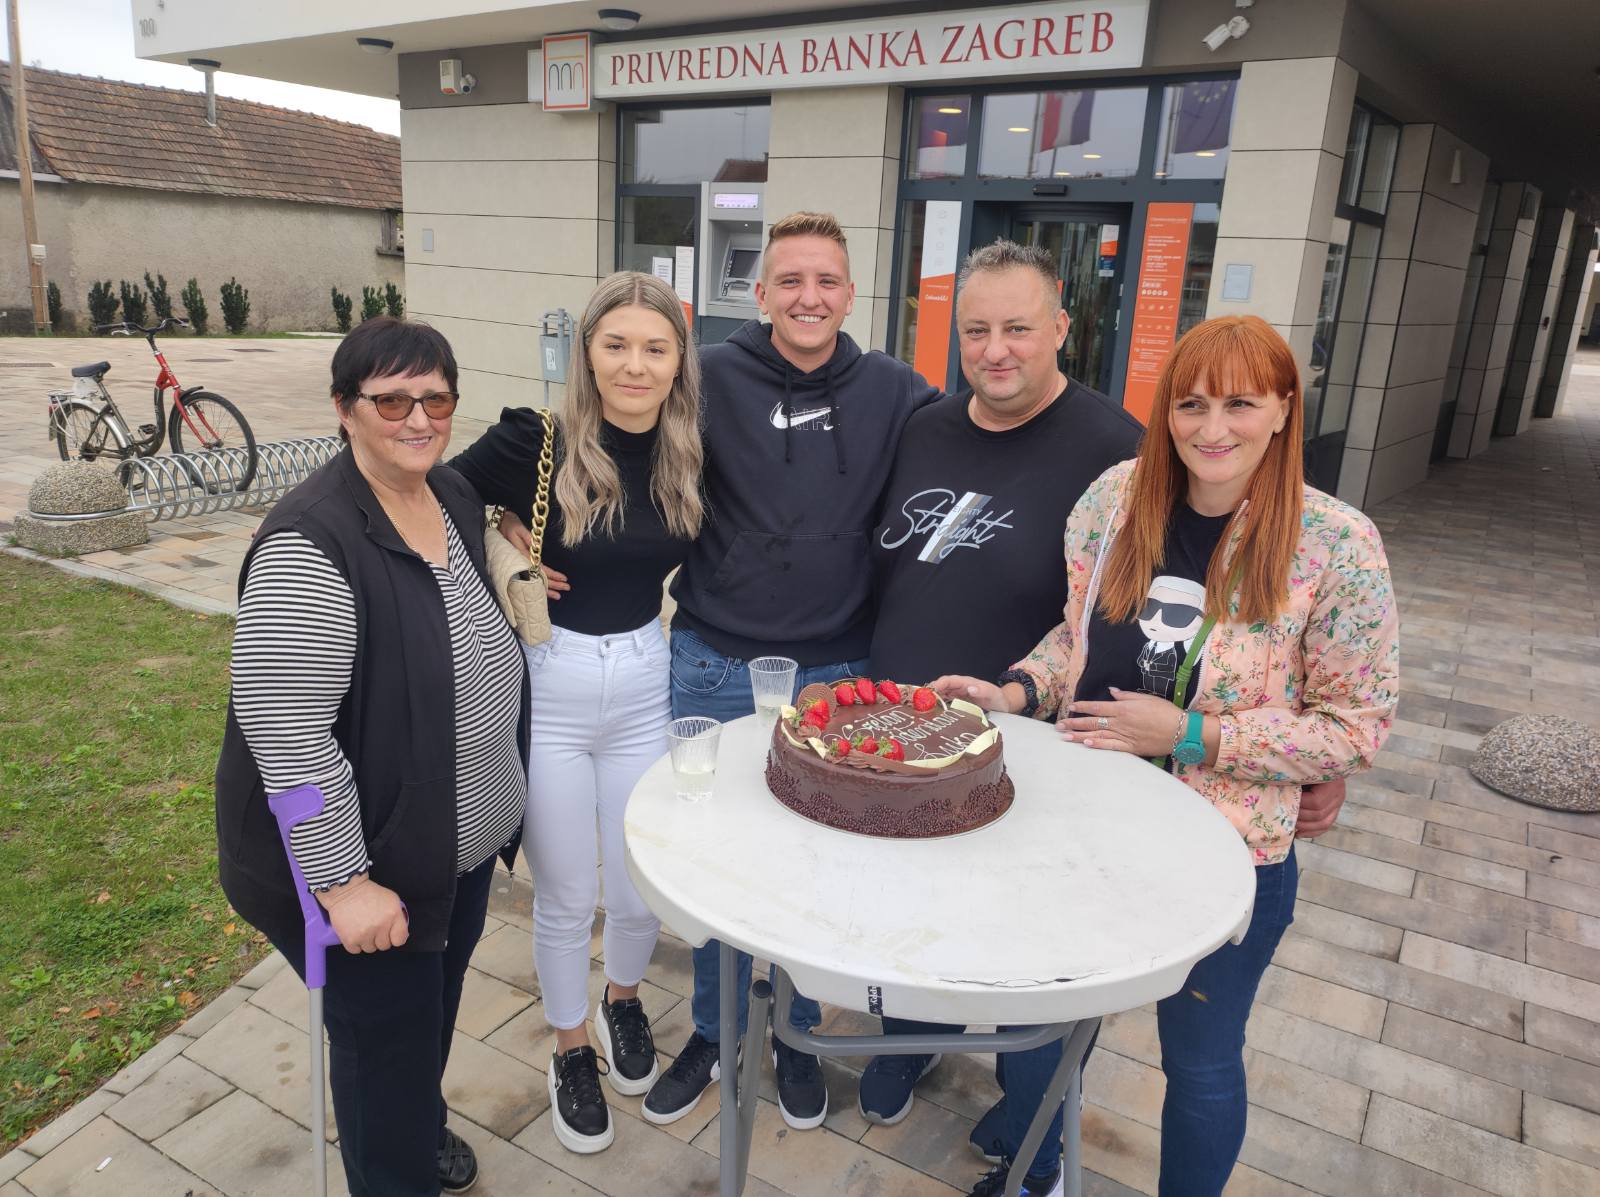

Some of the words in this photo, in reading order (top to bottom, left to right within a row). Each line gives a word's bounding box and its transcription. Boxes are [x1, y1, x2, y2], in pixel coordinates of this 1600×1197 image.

[610, 42, 789, 87] PRIVREDNA
[801, 30, 926, 74] BANKA
[940, 12, 1115, 63] ZAGREB
[881, 488, 1013, 560] Straight
